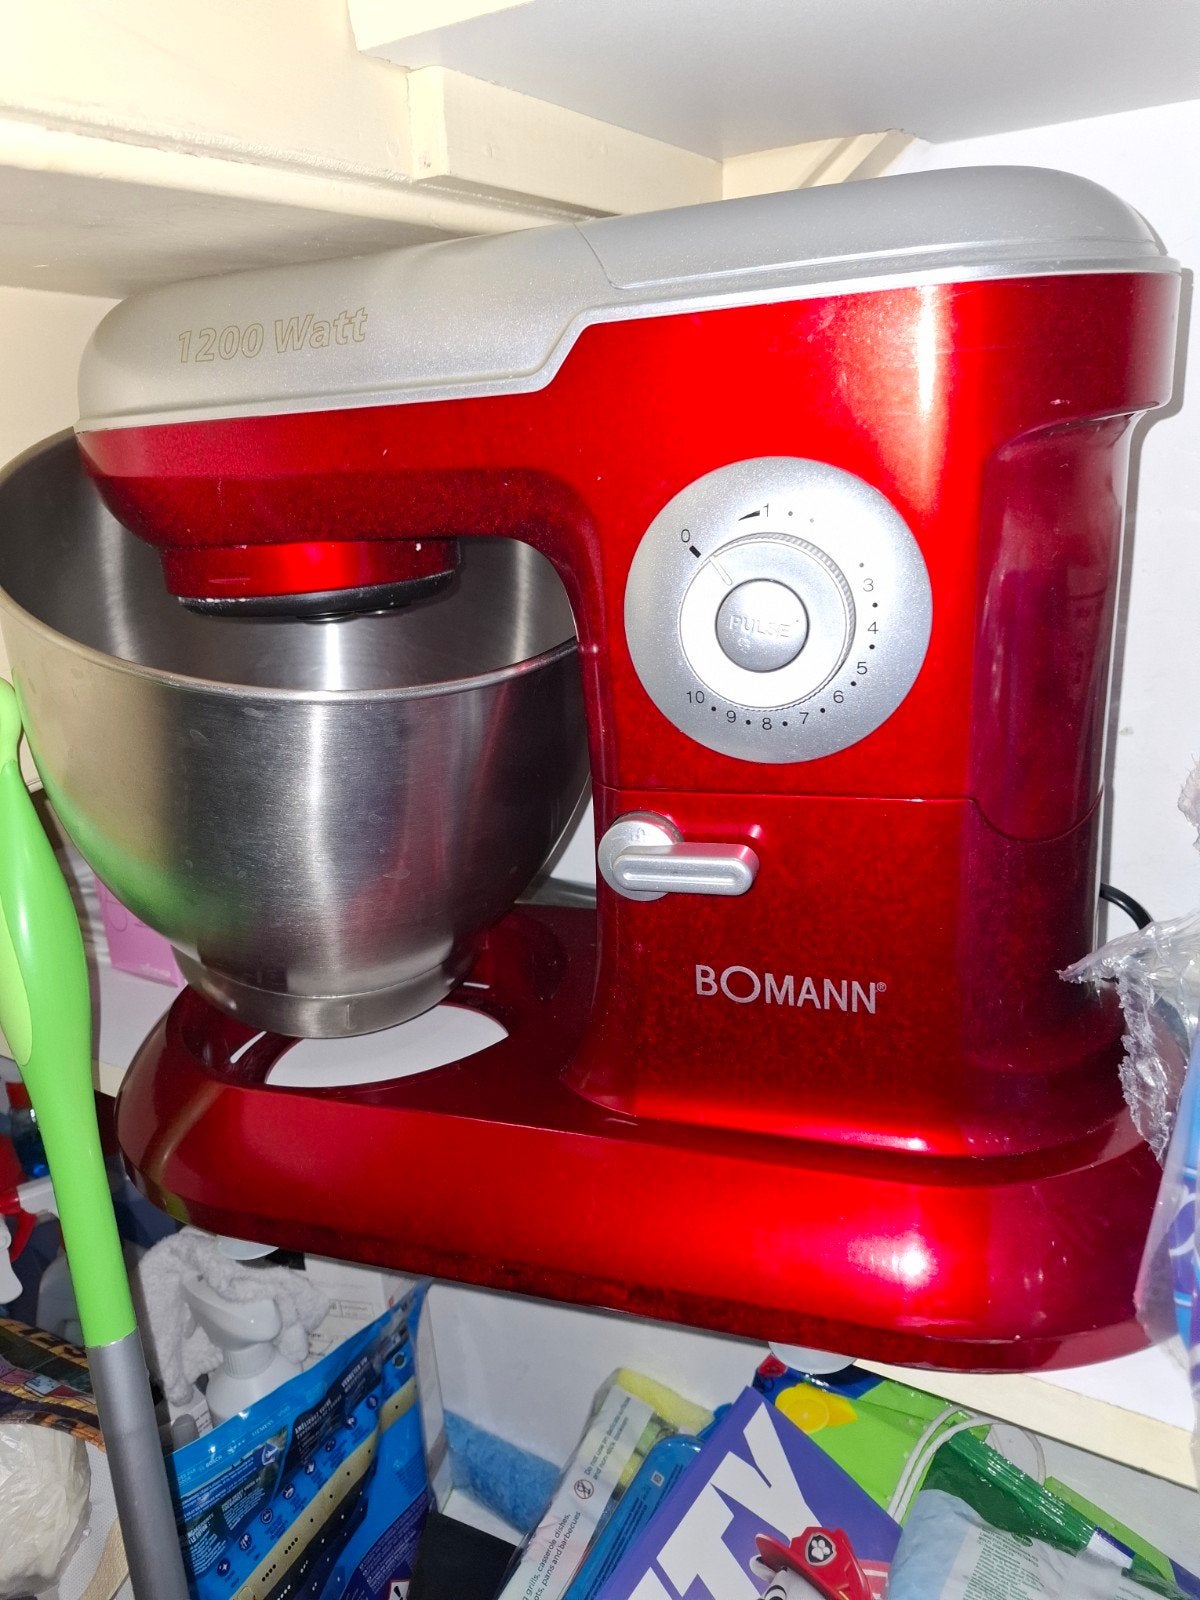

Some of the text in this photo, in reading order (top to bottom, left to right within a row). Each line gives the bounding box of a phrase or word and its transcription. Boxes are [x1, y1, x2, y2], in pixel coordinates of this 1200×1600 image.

[179, 306, 369, 363] 1200 Watt
[762, 503, 770, 518] 1
[680, 529, 691, 543] 0
[862, 578, 875, 593] 3
[729, 613, 793, 640] PULSE
[867, 621, 879, 635] 4
[856, 661, 868, 675] 5
[685, 690, 705, 704] 10
[833, 690, 845, 704] 6
[726, 710, 737, 724] 9
[761, 717, 773, 731] 8
[799, 712, 810, 725] 7
[558, 1510, 582, 1552] barbecues
[537, 1540, 558, 1573] casserole
[553, 1548, 564, 1566] and
[541, 1564, 556, 1587] pans
